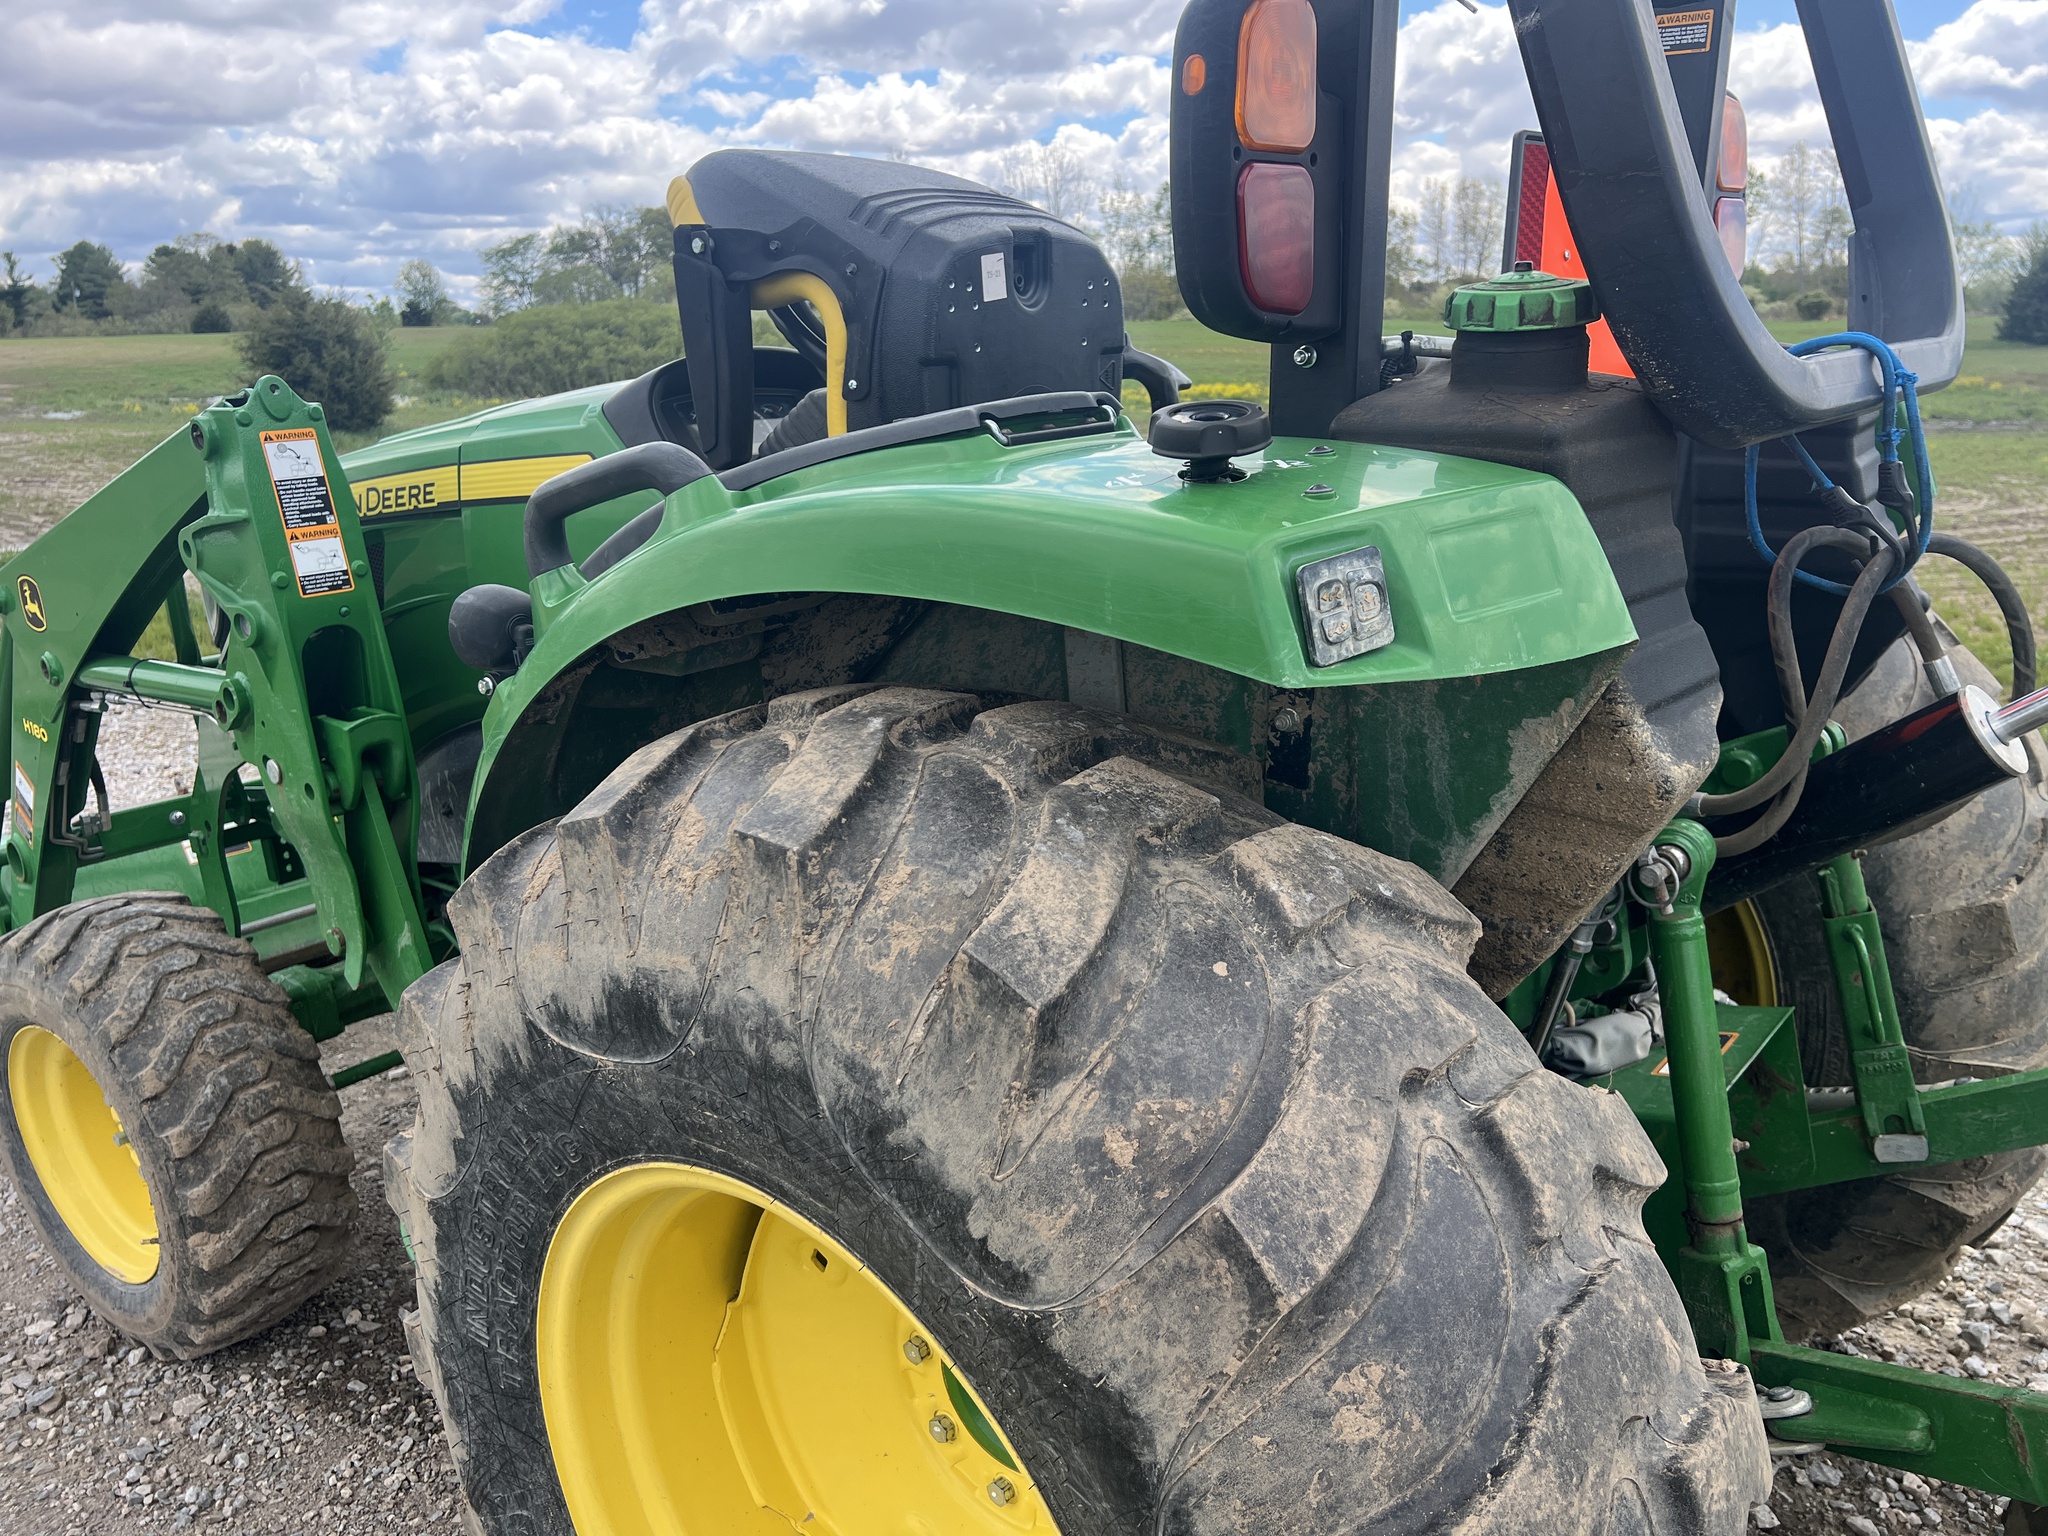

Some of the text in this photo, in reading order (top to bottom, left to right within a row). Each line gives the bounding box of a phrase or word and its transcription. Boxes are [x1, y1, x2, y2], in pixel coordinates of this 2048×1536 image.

[1666, 12, 1710, 24] WARNING
[274, 431, 314, 440] WARNING
[366, 482, 437, 514] DEERE
[300, 528, 339, 539] WARNING
[22, 718, 48, 742] H180
[465, 1124, 540, 1348] INDUSTRIAL
[496, 1130, 585, 1391] TRACTOR LUG
